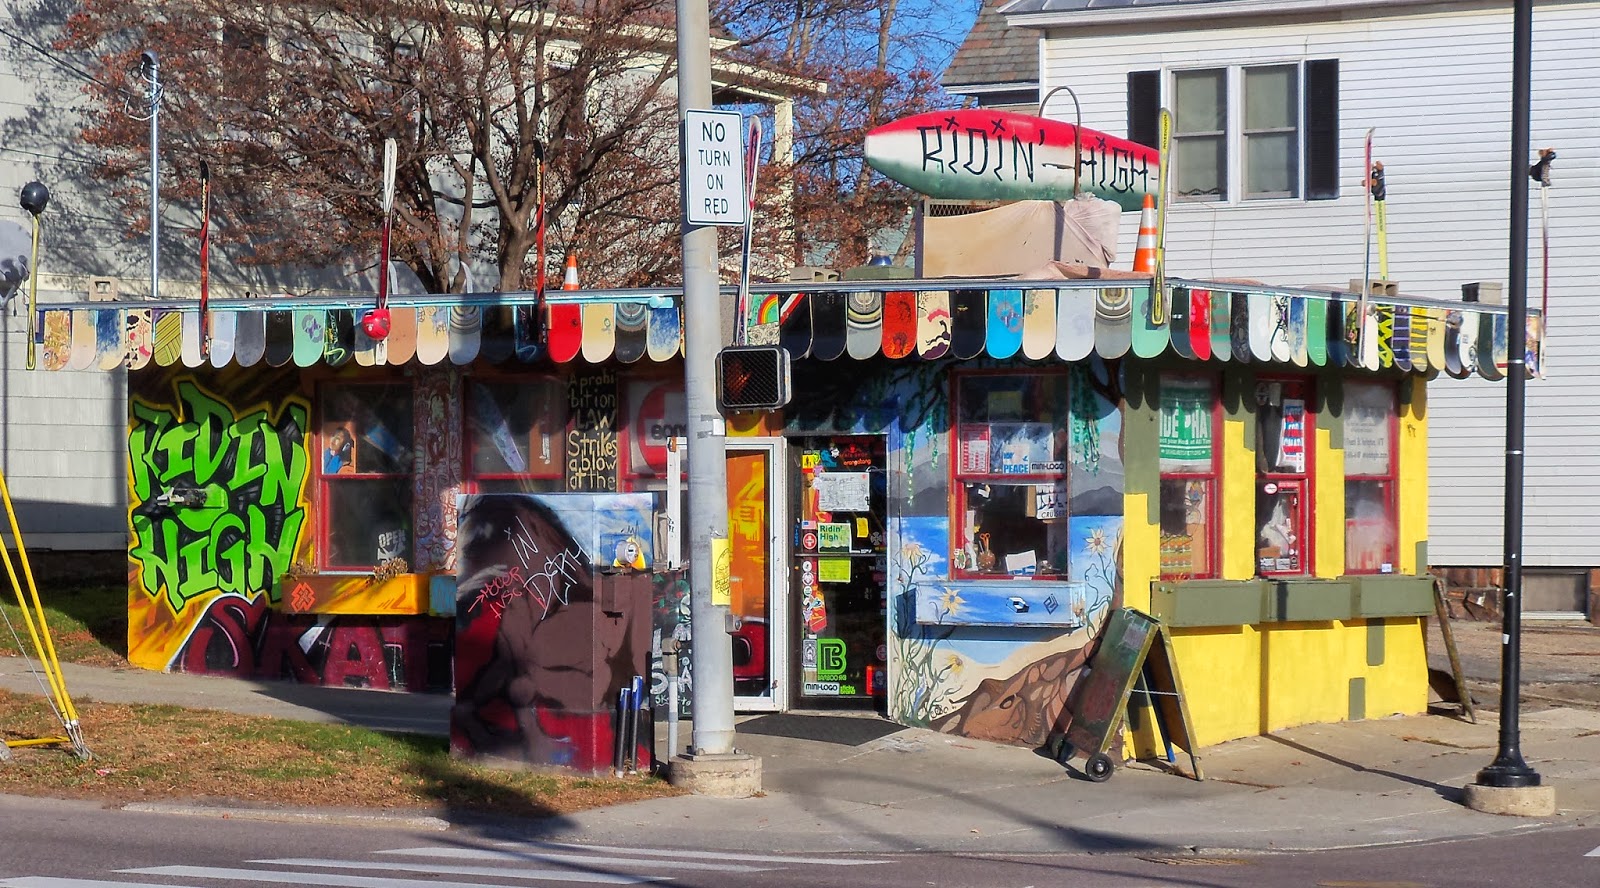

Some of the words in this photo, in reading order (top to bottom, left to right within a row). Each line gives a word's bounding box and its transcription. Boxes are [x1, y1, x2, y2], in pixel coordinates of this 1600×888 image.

[702, 121, 726, 143] NO
[698, 149, 731, 167] TURN
[706, 173, 724, 191] ON
[704, 197, 729, 214] RED
[577, 408, 617, 429] LAW
[1159, 404, 1179, 437] IDE
[1184, 404, 1211, 438] PHA
[568, 430, 617, 458] Strikes
[568, 458, 578, 472] a
[581, 449, 617, 471] blow
[1004, 464, 1028, 473] PEACE
[569, 467, 587, 490] at
[587, 469, 616, 491] the
[378, 530, 406, 548] OPEN
[820, 533, 838, 542] High
[129, 503, 304, 614] HIGH
